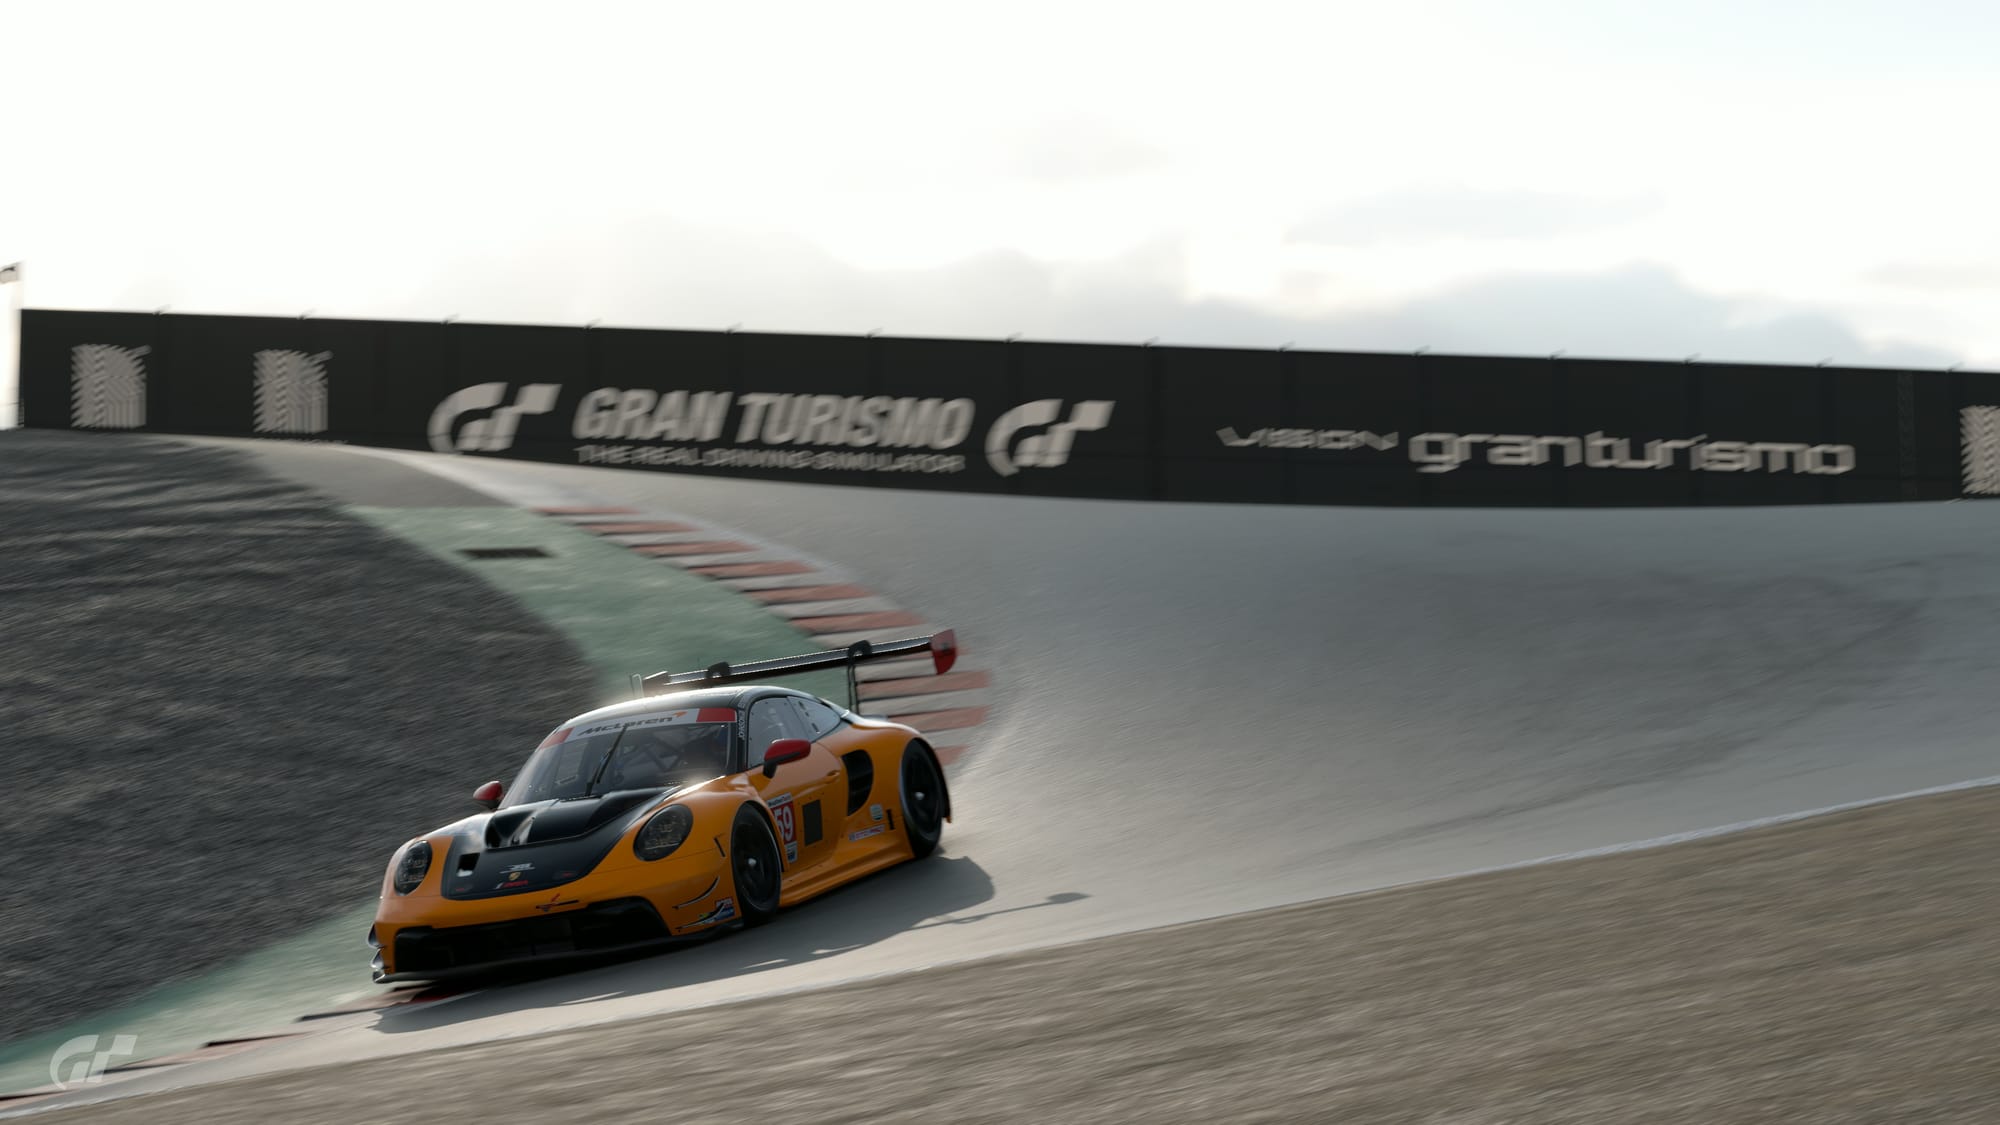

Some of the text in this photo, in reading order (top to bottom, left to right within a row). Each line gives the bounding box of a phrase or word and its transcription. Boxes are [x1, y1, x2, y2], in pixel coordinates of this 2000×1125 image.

[572, 387, 976, 450] GRAN TURISMO
[1216, 426, 1399, 451] VISION
[573, 445, 634, 465] THE
[630, 447, 703, 467] REAL
[811, 451, 966, 473] SIMULATOR
[577, 716, 673, 737] McLaren
[773, 805, 794, 841] 59
